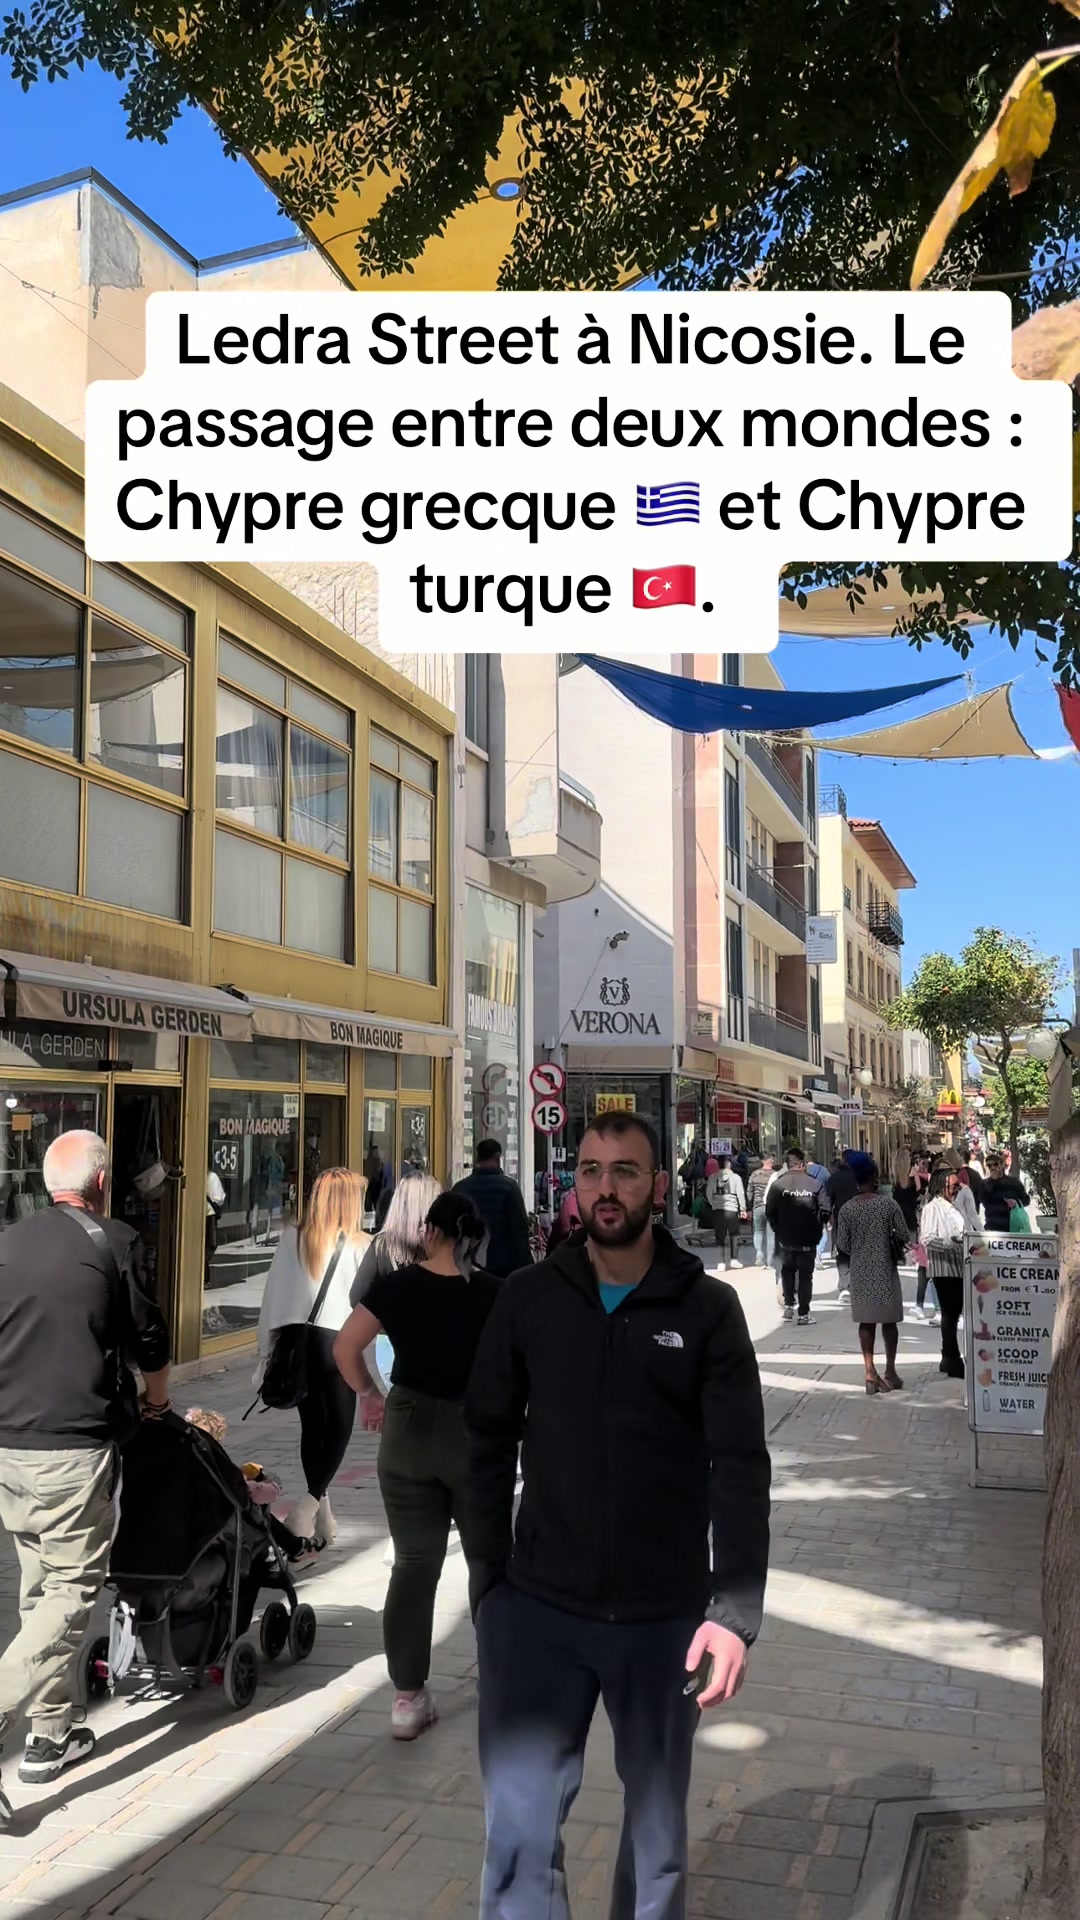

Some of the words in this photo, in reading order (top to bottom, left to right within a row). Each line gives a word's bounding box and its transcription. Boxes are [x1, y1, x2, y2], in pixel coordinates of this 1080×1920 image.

[62, 990, 146, 1027] URSULA
[152, 1004, 223, 1037] GERDEN
[570, 1009, 661, 1035] VERONA
[330, 1021, 354, 1043] BON
[356, 1025, 403, 1050] MAGIQUE
[40, 1033, 106, 1058] GERDEN
[598, 1097, 633, 1112] SALE
[537, 1107, 560, 1126] 15
[219, 1118, 242, 1135] BON
[245, 1118, 291, 1136] MAGIQUE
[988, 1240, 1003, 1250] ICE
[1005, 1241, 1040, 1251] CREAM
[997, 1267, 1017, 1278] ICE
[997, 1300, 1030, 1311] SOFT
[997, 1326, 1050, 1338] GRANITA
[998, 1348, 1039, 1359] SCOOP
[998, 1371, 1025, 1382] FRESH
[999, 1398, 1035, 1409] WATER
